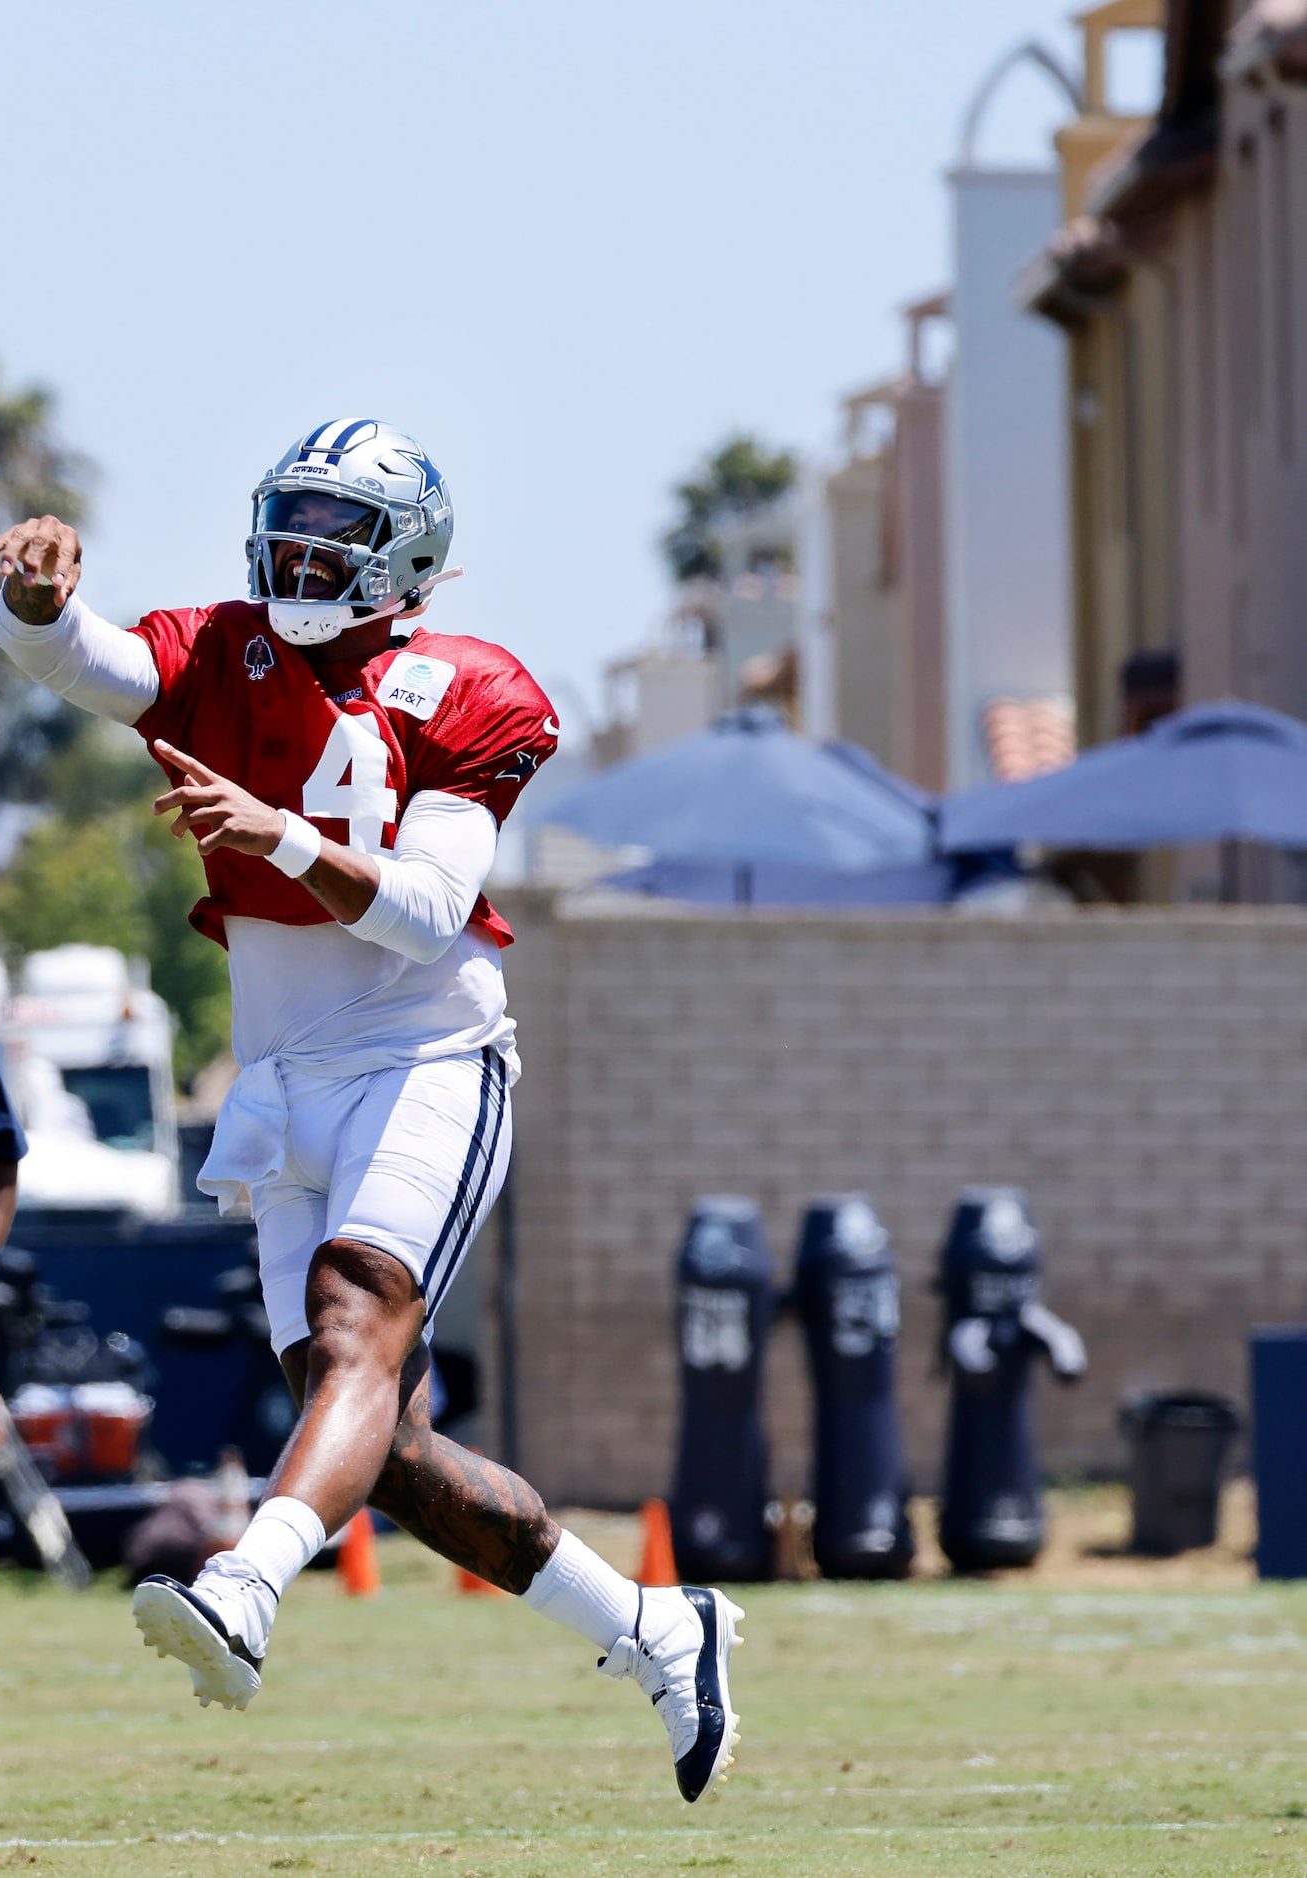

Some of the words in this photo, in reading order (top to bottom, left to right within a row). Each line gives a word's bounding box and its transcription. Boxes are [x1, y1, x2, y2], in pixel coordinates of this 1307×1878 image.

[292, 466, 329, 475] COWBOYS
[388, 688, 426, 708] AT&T
[302, 711, 398, 861] 4
